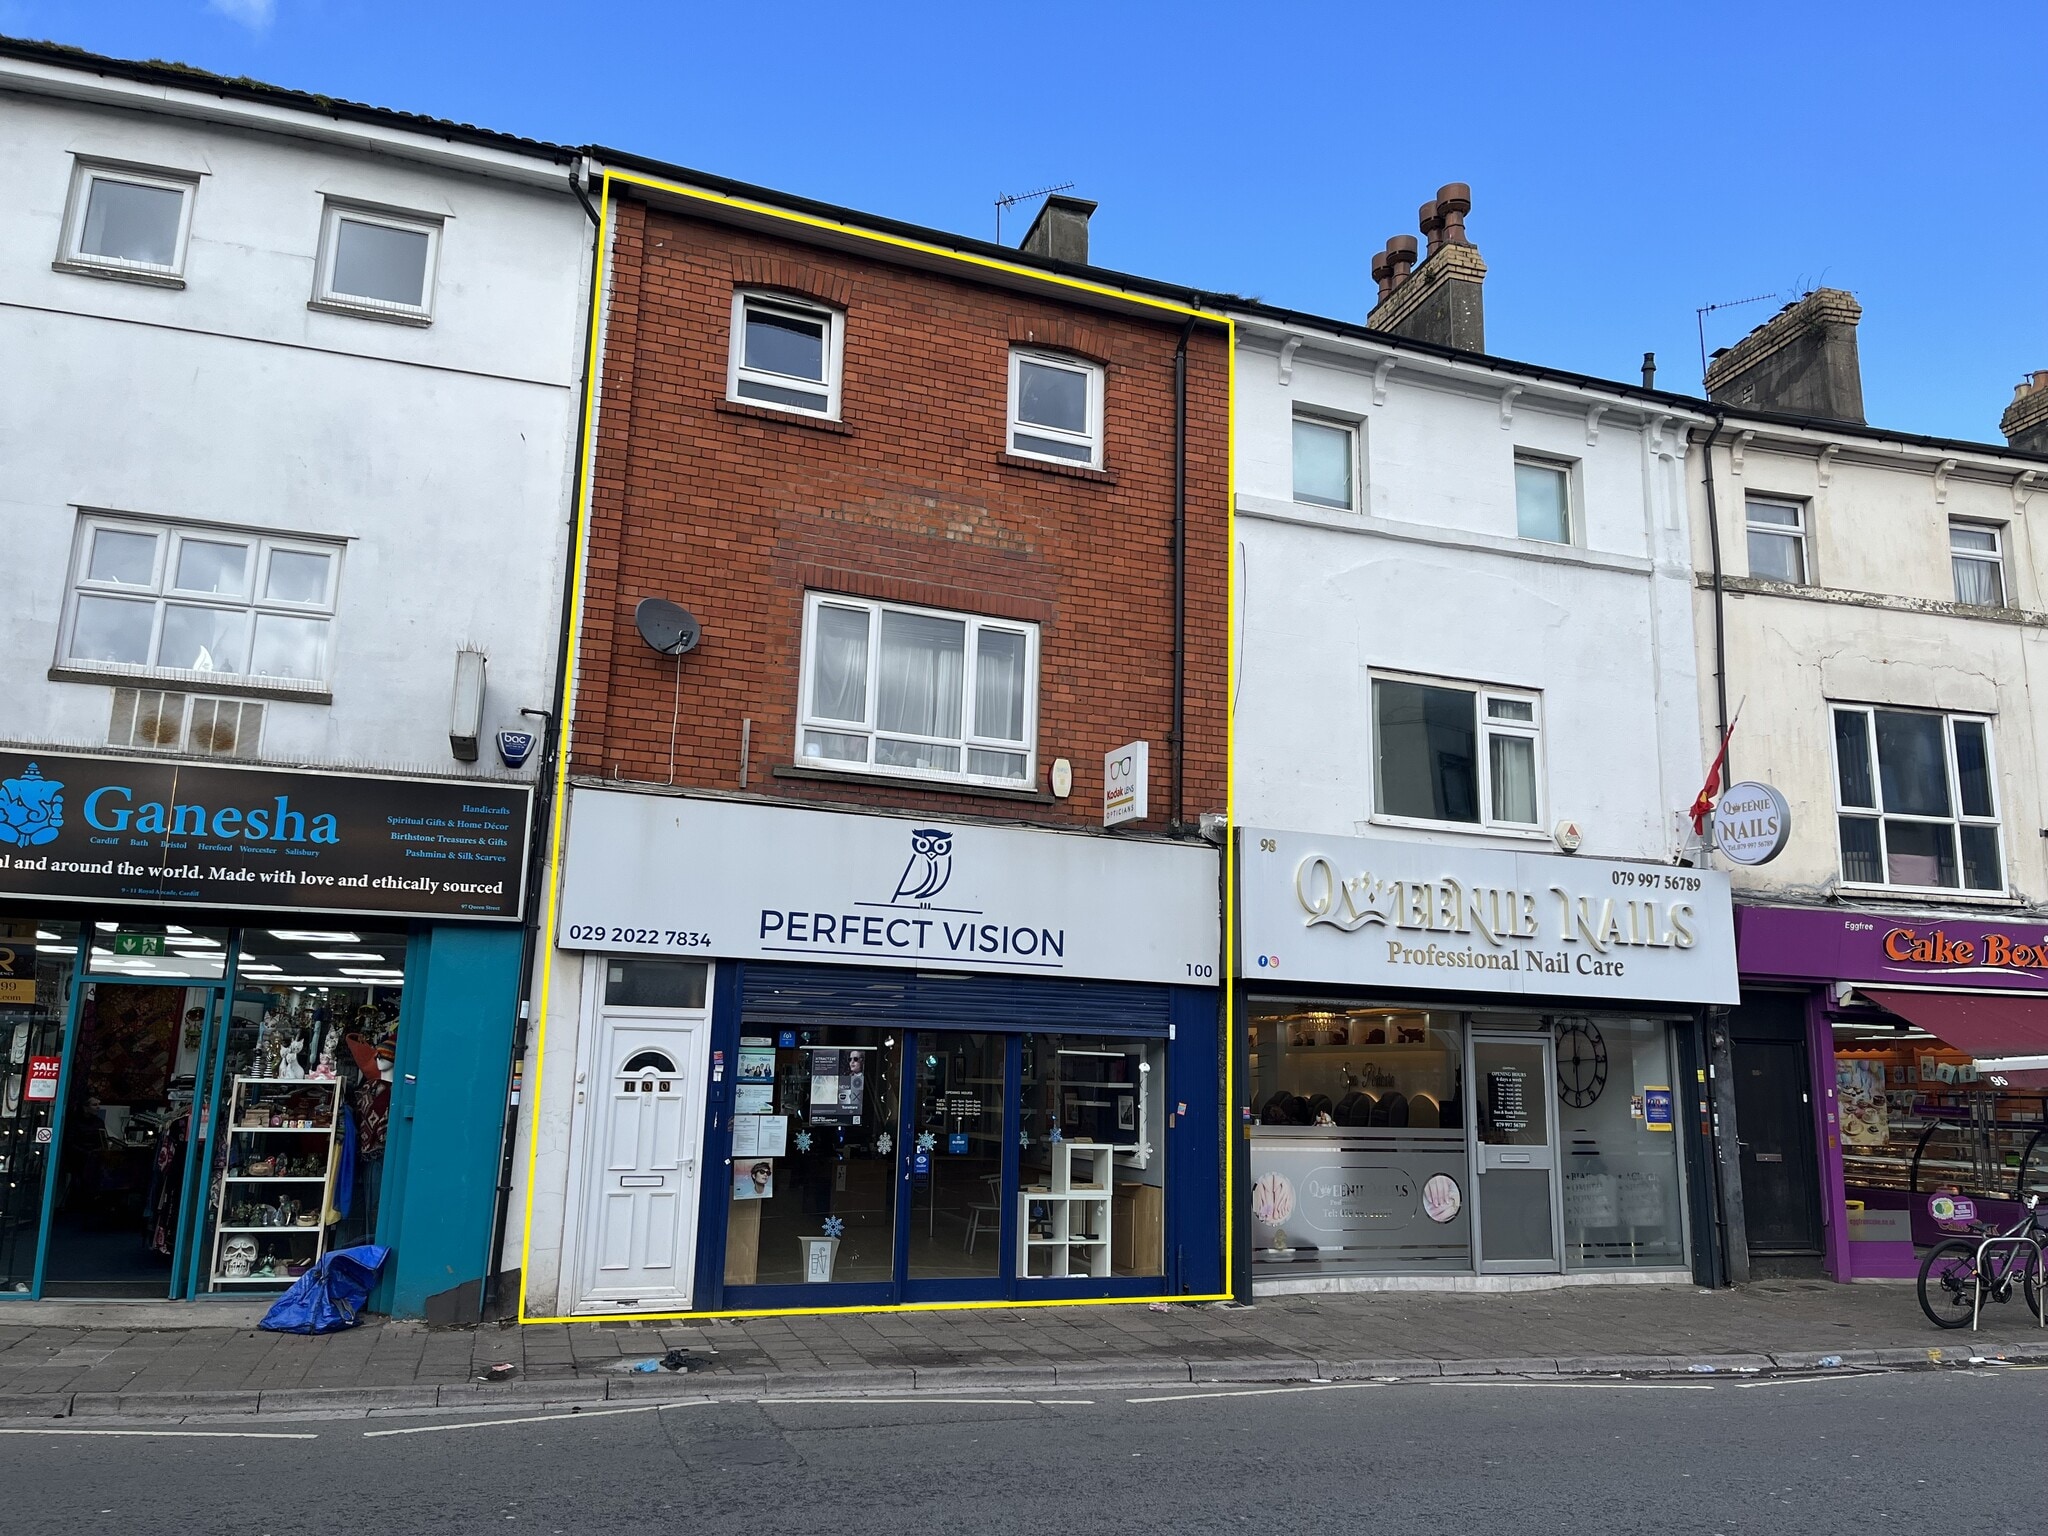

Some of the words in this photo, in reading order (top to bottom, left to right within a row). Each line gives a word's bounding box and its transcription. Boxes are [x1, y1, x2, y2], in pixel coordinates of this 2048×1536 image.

[1106, 786, 1124, 800] Kodak
[1124, 785, 1134, 795] LENS
[84, 786, 340, 845] Ganesha
[462, 804, 511, 815] Handicrafts
[1106, 805, 1134, 819] OPTICIANS
[387, 815, 424, 827] Spiritual
[425, 818, 446, 828] Gifts
[448, 819, 455, 828] &
[457, 820, 482, 829] Home
[484, 820, 510, 831] Décor
[1719, 816, 1778, 843] NAILS
[90, 836, 120, 846] Cardiff
[130, 838, 149, 847] Bath
[160, 840, 187, 850] Bristol
[198, 843, 232, 852] Hereford
[240, 845, 277, 855] Worcester
[285, 848, 320, 858] Salisbury
[390, 832, 436, 843] Birthstone
[436, 834, 477, 845] Treasures
[478, 837, 486, 845] &
[488, 837, 508, 847] Gifts
[1260, 838, 1277, 852] 98
[405, 849, 447, 860] Pashmina
[448, 851, 455, 860] &
[457, 852, 474, 861] Silk
[475, 853, 506, 863] Scarves
[14, 857, 47, 871] and
[51, 861, 113, 875] around
[117, 861, 144, 876] the
[149, 865, 204, 879] world.
[208, 866, 256, 882] Made
[259, 870, 296, 884] with
[300, 871, 334, 886] love
[338, 874, 368, 888] and
[372, 875, 440, 894] ethically
[443, 881, 503, 894] sourced
[1612, 870, 1635, 886] 079
[1638, 873, 1660, 889] 997
[1664, 876, 1701, 892] 56789
[1296, 854, 1540, 946] QUEENIE
[1550, 886, 1699, 953] NAILS
[760, 909, 933, 949] PERFECT
[943, 921, 1064, 957] VISION
[1845, 921, 1874, 932] Eggfree
[569, 925, 606, 941] 029
[611, 928, 659, 944] 2022
[665, 931, 712, 947] 7834
[1882, 928, 1975, 965] Cake
[1980, 934, 2048, 968] Box
[1387, 939, 1520, 971] Professional
[1525, 950, 1569, 974] Nail
[1576, 953, 1625, 977] Care
[1186, 964, 1212, 978] 100
[33, 1062, 59, 1071] SALE
[1990, 1076, 2008, 1086] 96
